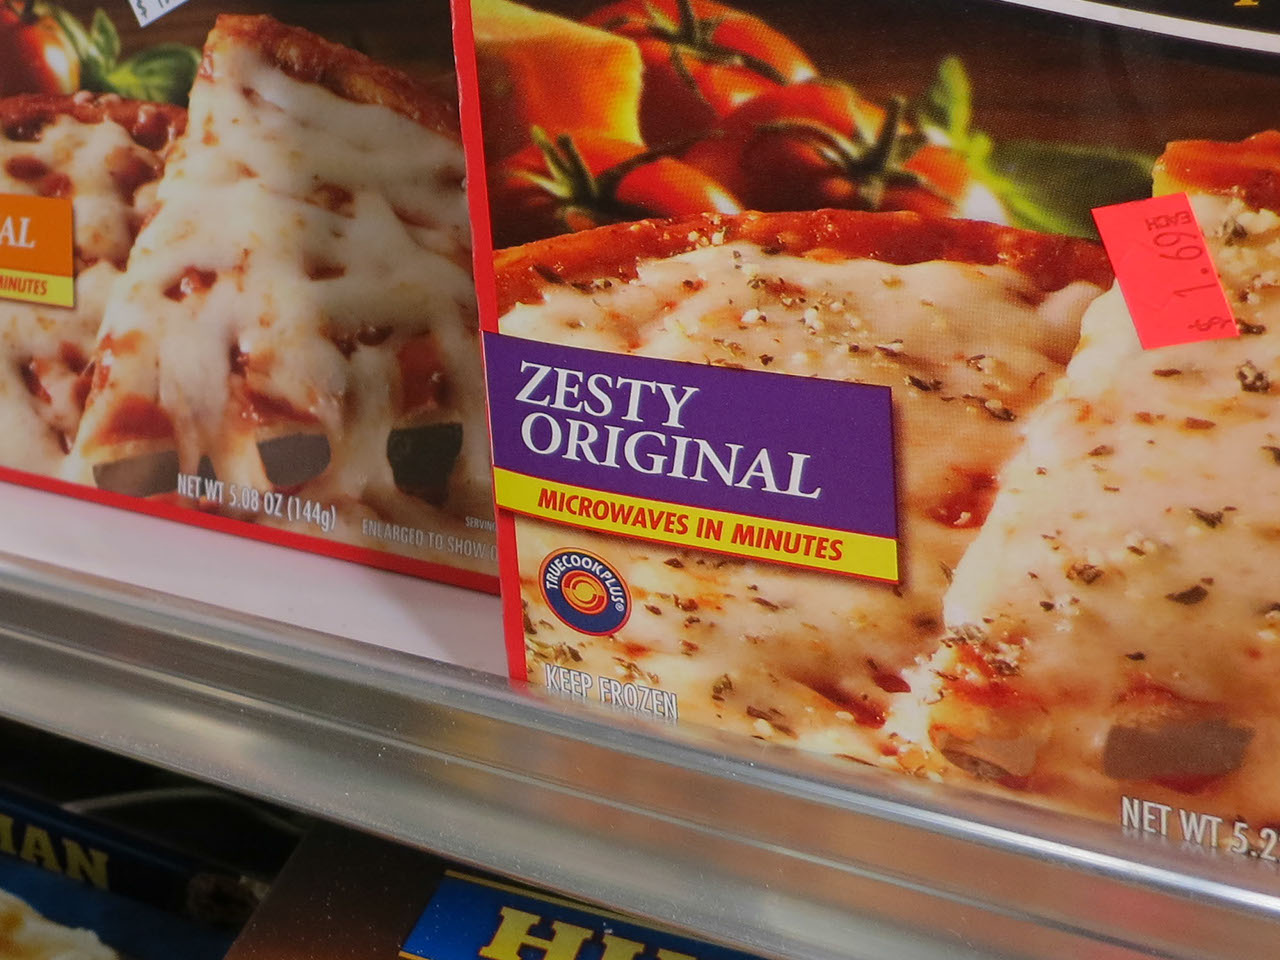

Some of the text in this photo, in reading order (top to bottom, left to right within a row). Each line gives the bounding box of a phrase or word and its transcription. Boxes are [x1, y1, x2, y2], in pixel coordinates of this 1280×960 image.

[515, 360, 699, 428] ZESTY
[521, 411, 821, 500] ORIGINAL
[178, 474, 337, 534] NET WT 5.08 OZ (144g)
[538, 487, 843, 561] MICROWAVES IN MINUTES
[361, 518, 425, 548] ENLARGED
[426, 531, 444, 551] TO
[447, 535, 488, 560] SHOW
[545, 663, 679, 720] KEEP FROZEN
[1121, 795, 1172, 836] NET
[1179, 808, 1224, 847] WT
